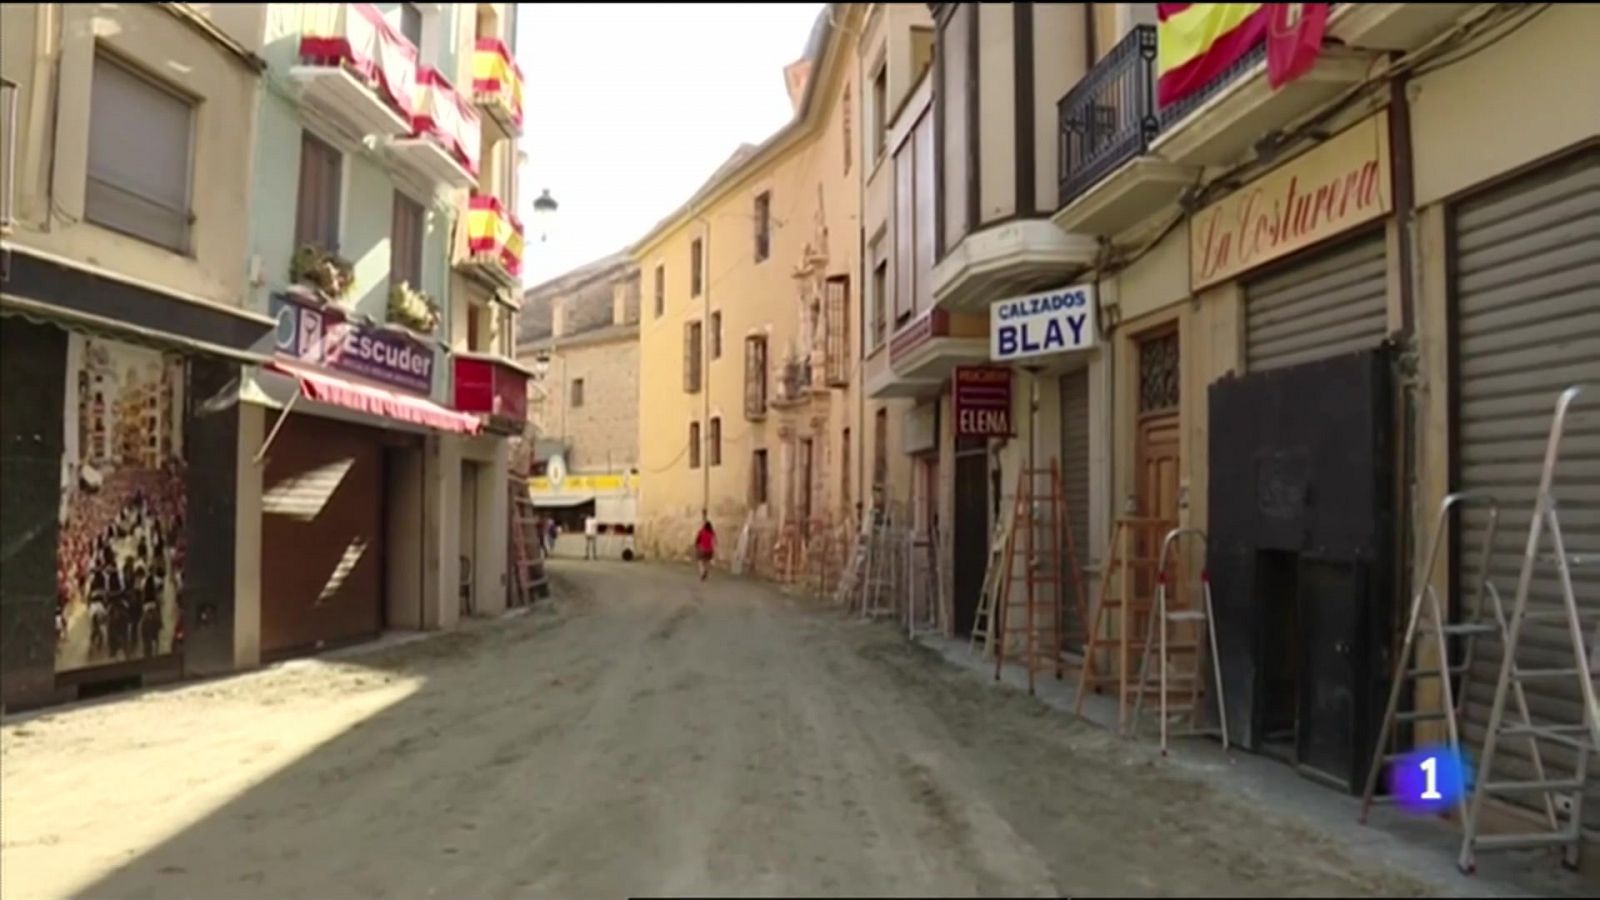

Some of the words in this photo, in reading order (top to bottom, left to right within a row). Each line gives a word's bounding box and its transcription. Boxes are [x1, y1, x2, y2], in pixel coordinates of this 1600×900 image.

[1199, 205, 1231, 279] La
[1237, 160, 1379, 263] Costurera
[998, 291, 1086, 320] CALZADOS
[344, 329, 431, 376] Escuder
[998, 314, 1086, 355] BLAY
[960, 409, 1007, 432] ELENA
